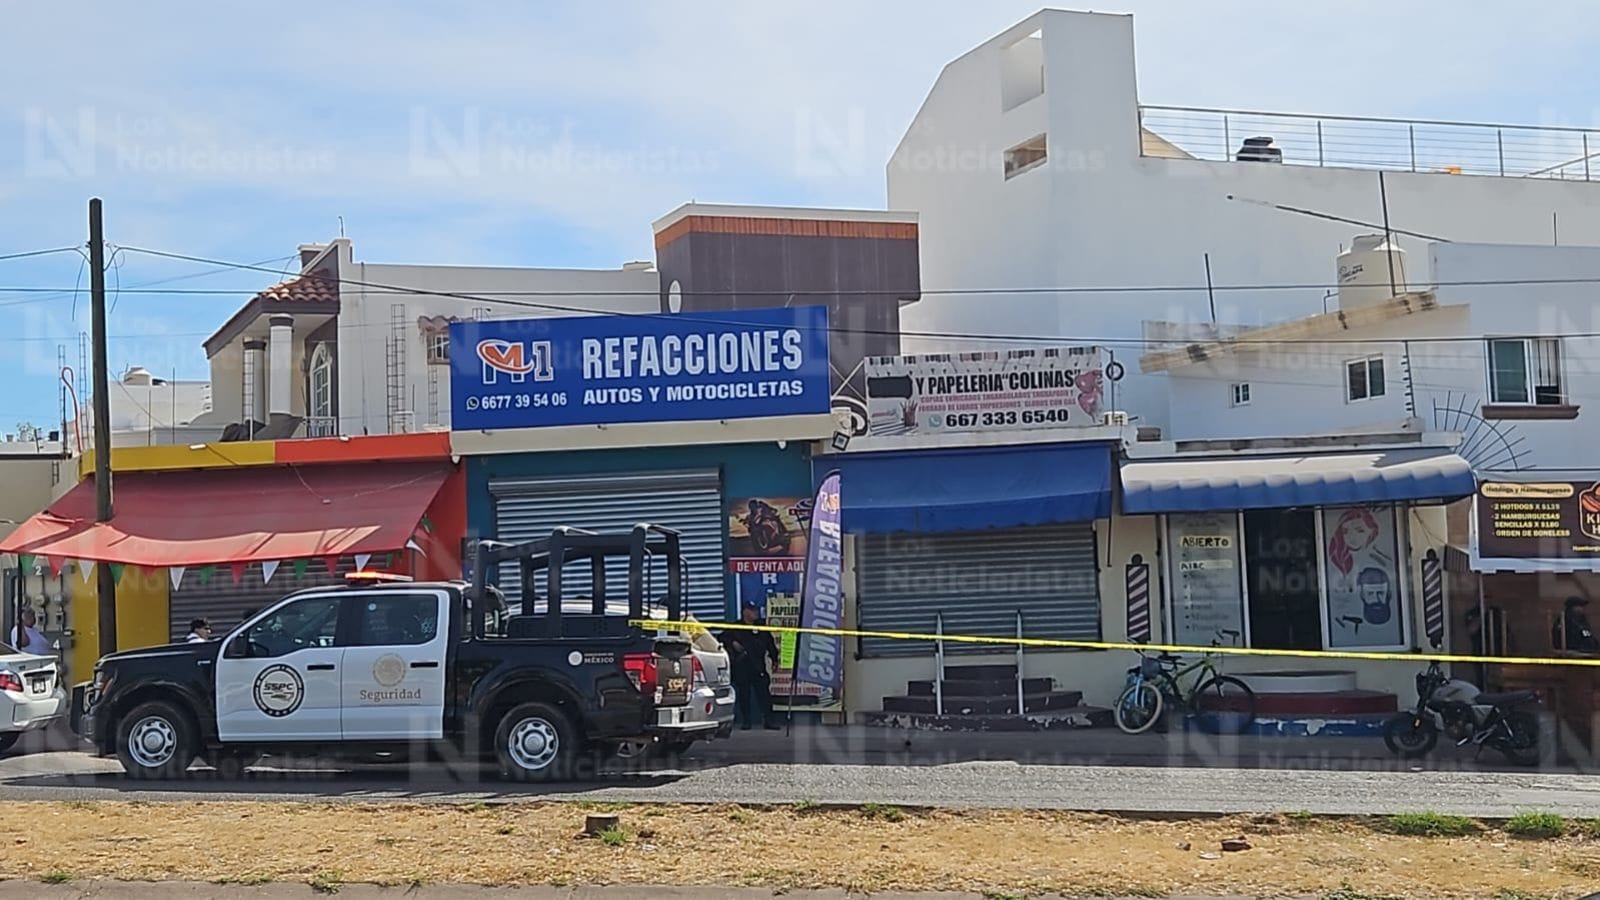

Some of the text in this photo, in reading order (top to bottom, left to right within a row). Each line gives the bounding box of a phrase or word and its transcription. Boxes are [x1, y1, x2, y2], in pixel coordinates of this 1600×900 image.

[582, 329, 802, 379] REFACCIONES
[915, 377, 925, 395] Y
[928, 373, 1004, 394] PAPELERIA
[583, 380, 803, 405] AUTOS Y MOTOCICLETAS
[481, 392, 567, 409] 6677 39 54 06
[945, 409, 1069, 427] 667 333 6540
[1182, 537, 1229, 547] ABIERTO
[35, 565, 42, 576] 2
[737, 562, 750, 572] DE
[752, 561, 784, 572] VENTA
[53, 639, 60, 650] 4
[360, 689, 421, 703] Seguridad
